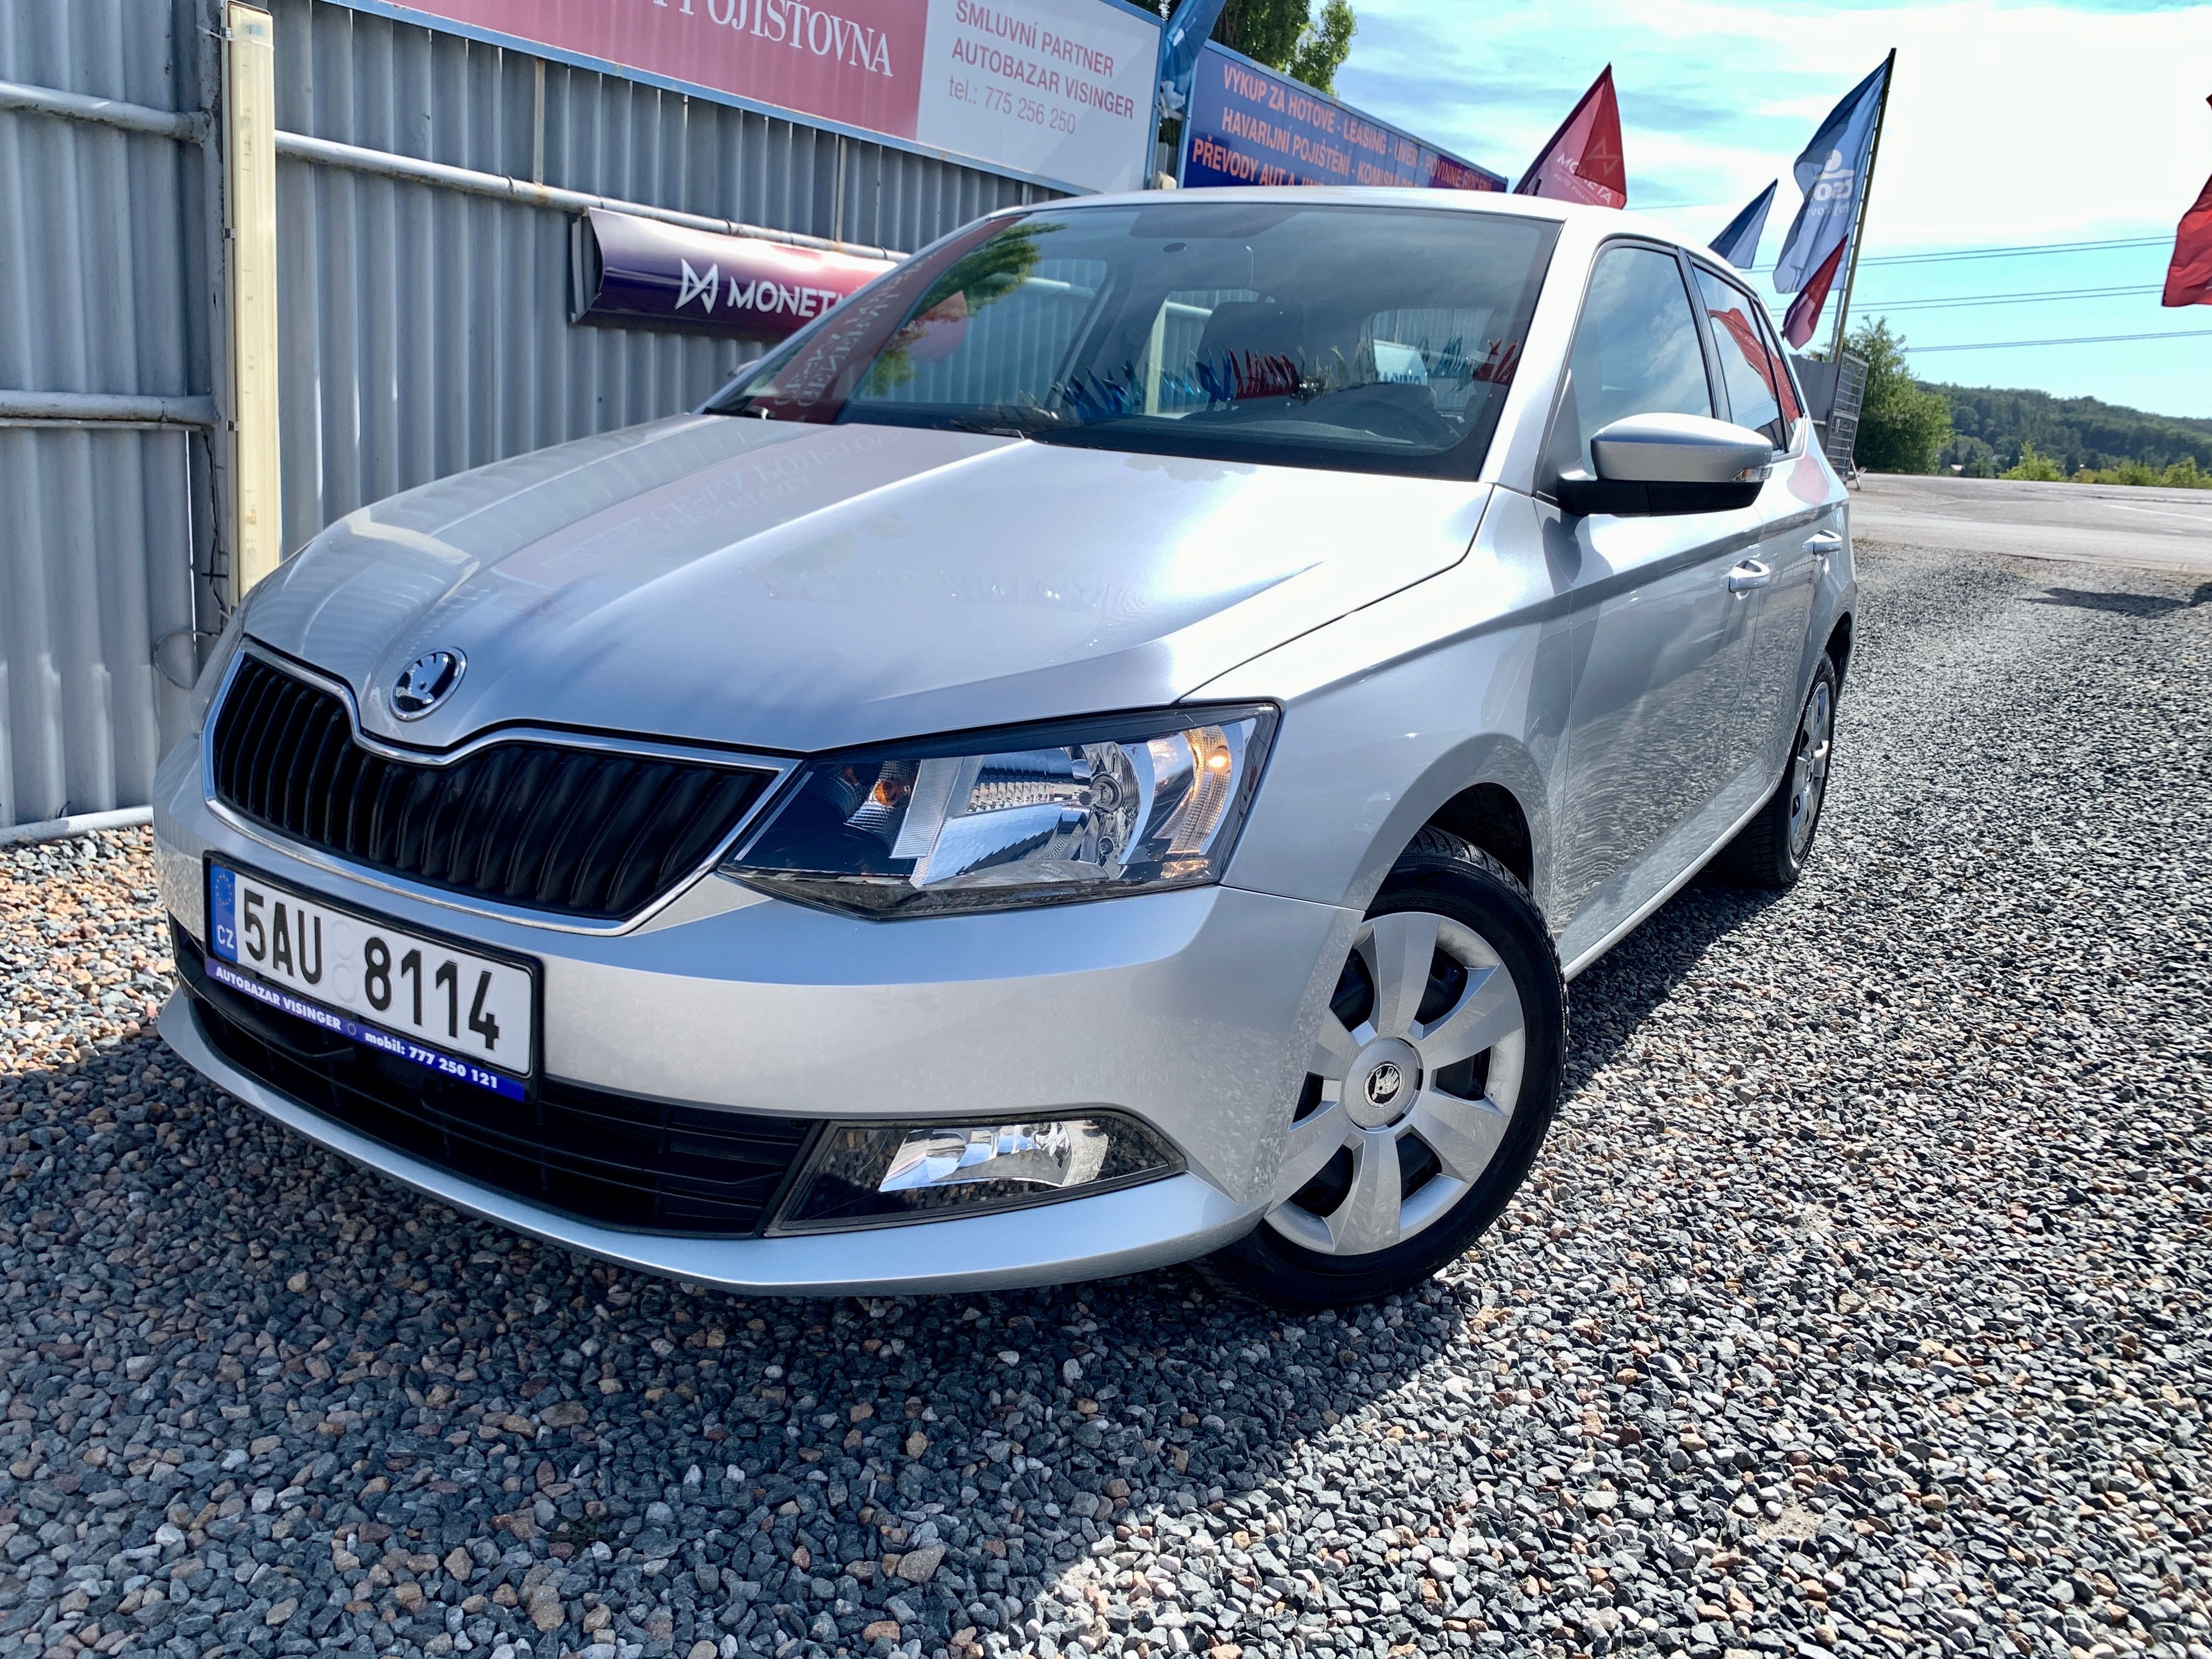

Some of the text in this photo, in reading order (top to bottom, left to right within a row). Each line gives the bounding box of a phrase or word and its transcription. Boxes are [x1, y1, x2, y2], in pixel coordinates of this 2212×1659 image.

[956, 0, 1114, 78] SMLUVNÍ PARTNER
[949, 75, 1076, 135] tel.: 775 256 250
[951, 37, 1134, 119] AUTOBAZAR VISINGER
[1221, 106, 1293, 154] HAVARIJNÍ
[1291, 134, 1352, 176] POJIŠTĚNÍ
[1268, 84, 1285, 113] ZA
[1343, 117, 1387, 156] LEASING
[1192, 135, 1259, 182] PŘEVODY
[1259, 163, 1286, 186] AUT
[217, 924, 235, 951] CZ
[244, 888, 500, 1051] 5AU 8114
[216, 965, 498, 1090] AUTOBAZAR VISINGER mobil: 777 250 121
